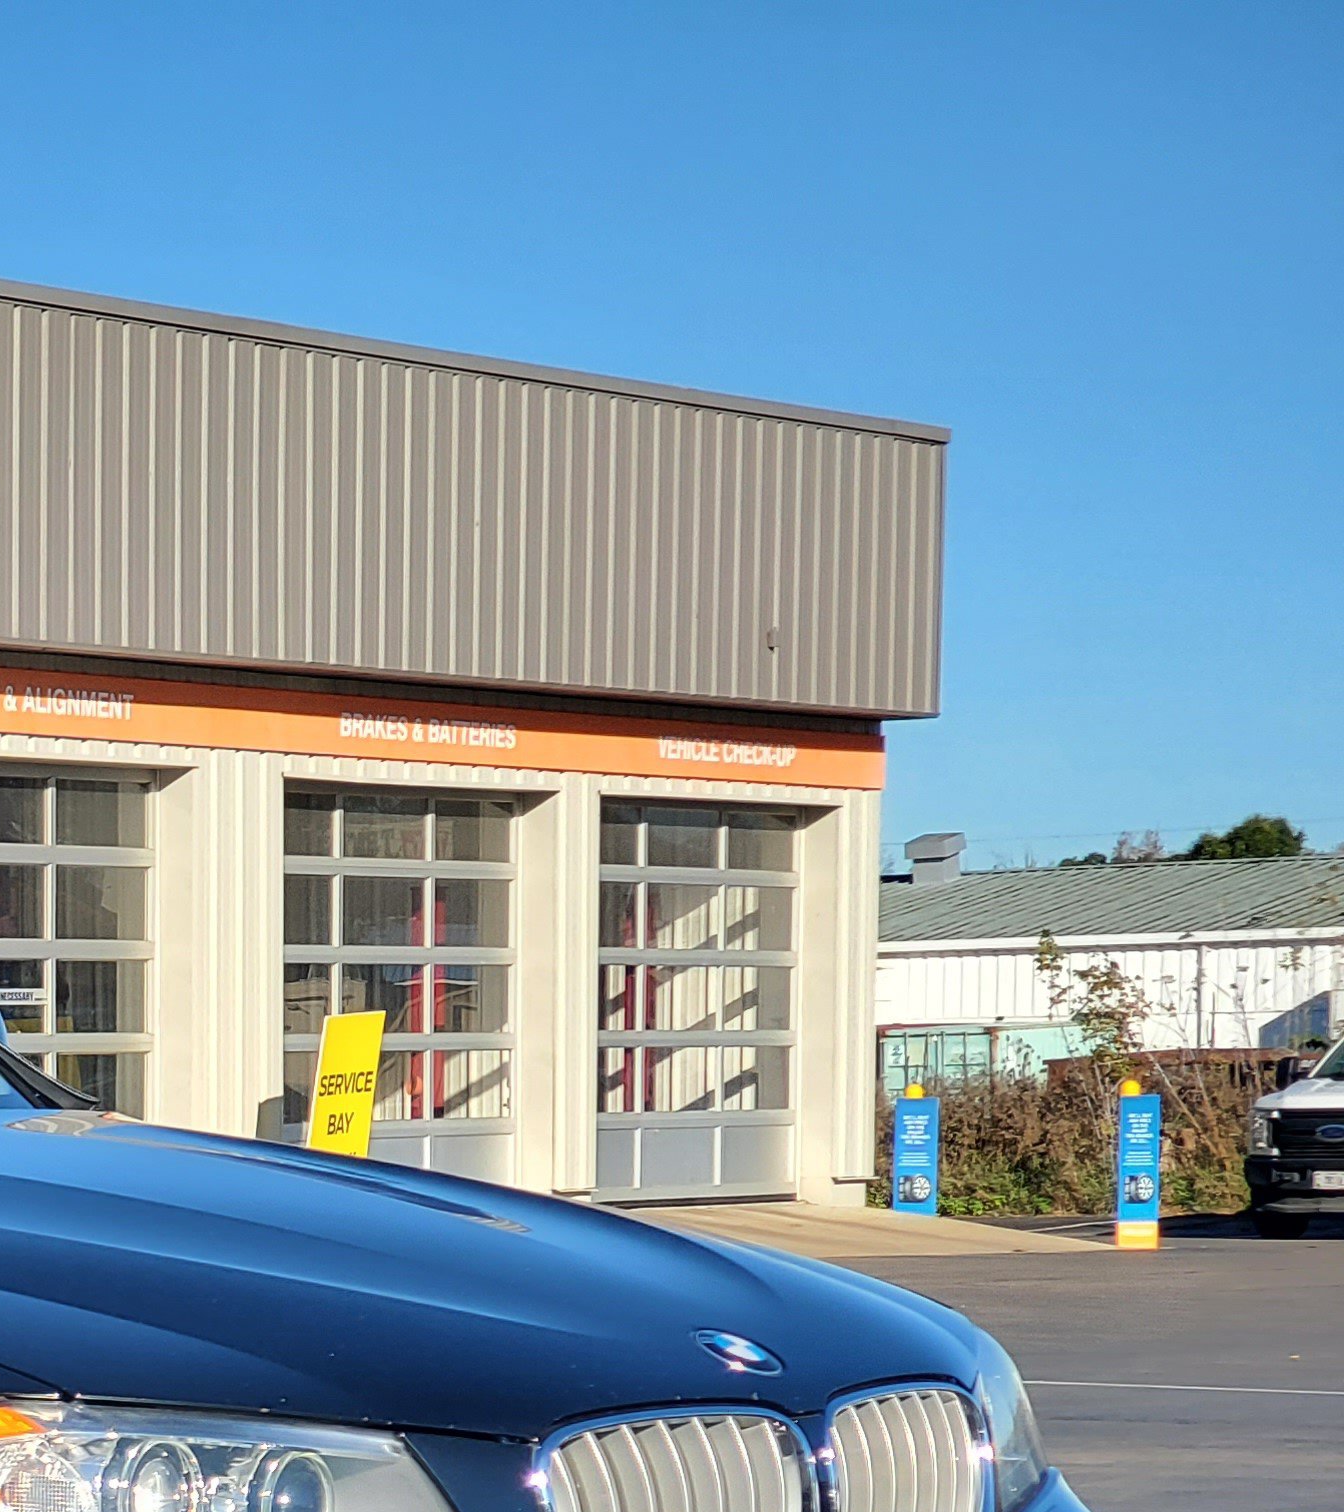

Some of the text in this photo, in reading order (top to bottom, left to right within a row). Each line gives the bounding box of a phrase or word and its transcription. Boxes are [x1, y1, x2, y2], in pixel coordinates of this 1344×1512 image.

[3, 685, 18, 712] &
[21, 686, 134, 720] ALIGNMENT
[339, 712, 517, 749] BRAKES & BATTERIES
[658, 735, 798, 767] VEHICLE CHECK-UP
[318, 1070, 374, 1097] SERVICE
[326, 1112, 355, 1136] BAY
